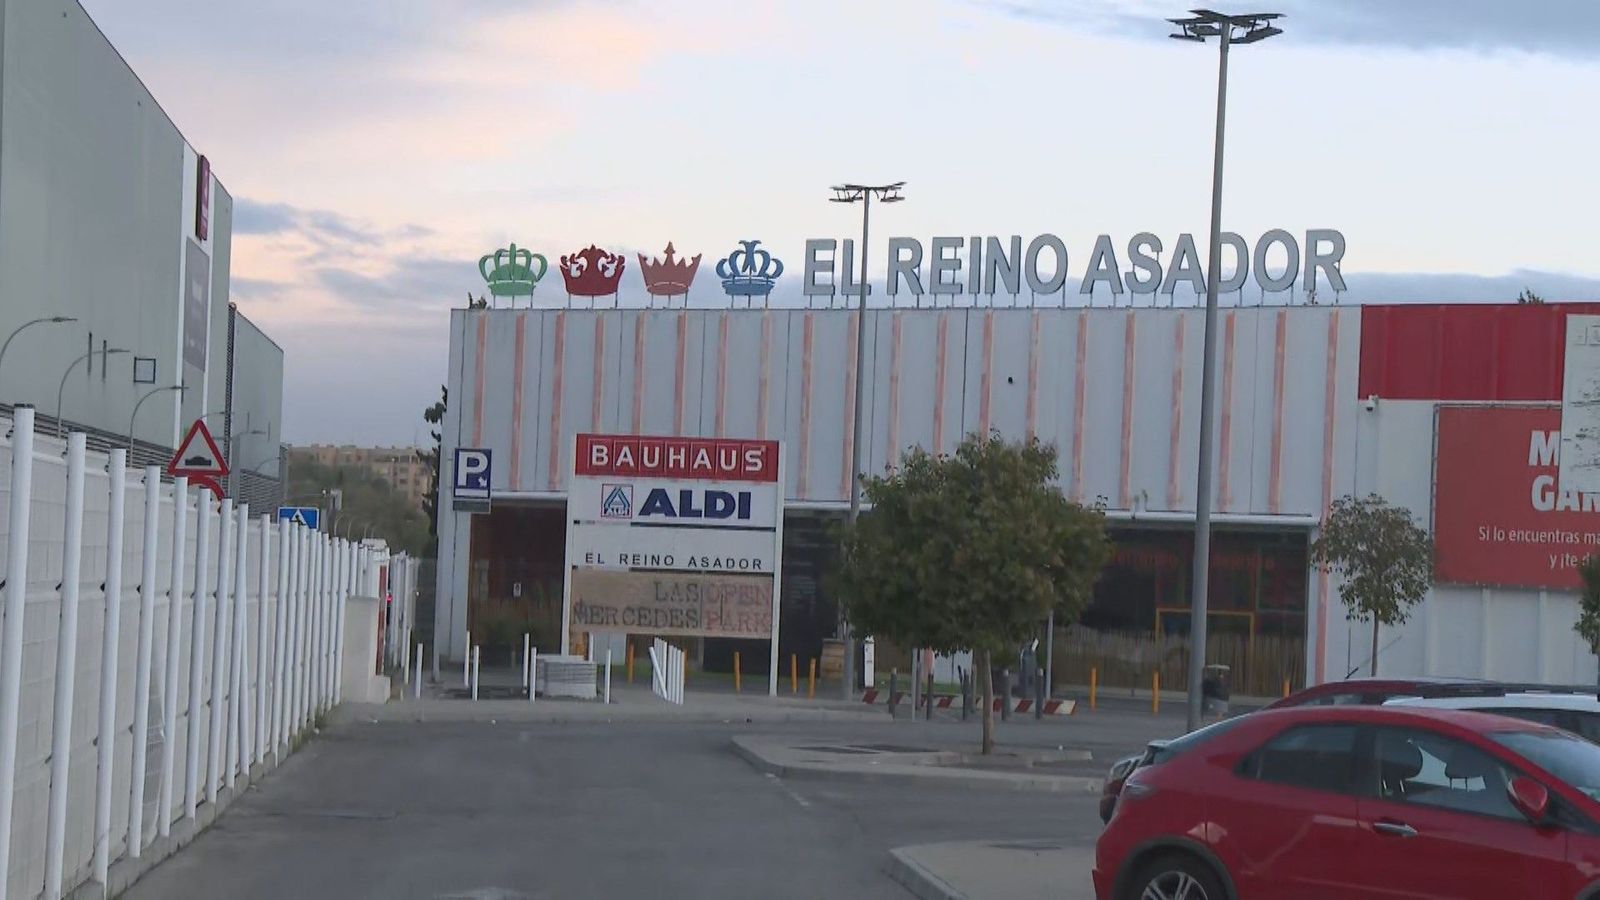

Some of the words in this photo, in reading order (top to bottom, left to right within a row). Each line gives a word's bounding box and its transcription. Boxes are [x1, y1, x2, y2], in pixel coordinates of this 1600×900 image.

[803, 238, 872, 296] EL
[886, 233, 1068, 296] REINO
[1080, 228, 1347, 295] ASADOR
[457, 450, 488, 487] P
[591, 444, 764, 472] BAUHAUS
[639, 488, 751, 520] ALDI
[1479, 526, 1490, 541] Si
[1494, 526, 1505, 541] lo
[1509, 528, 1580, 544] encuentras
[585, 552, 605, 564] EL
[619, 553, 675, 566] REINO
[688, 556, 762, 569] ASADOR
[1550, 554, 1557, 569] y
[654, 581, 699, 603] LAS
[705, 583, 770, 606] OPEN
[572, 601, 699, 629] MERCEDES
[705, 609, 770, 632] PARK
